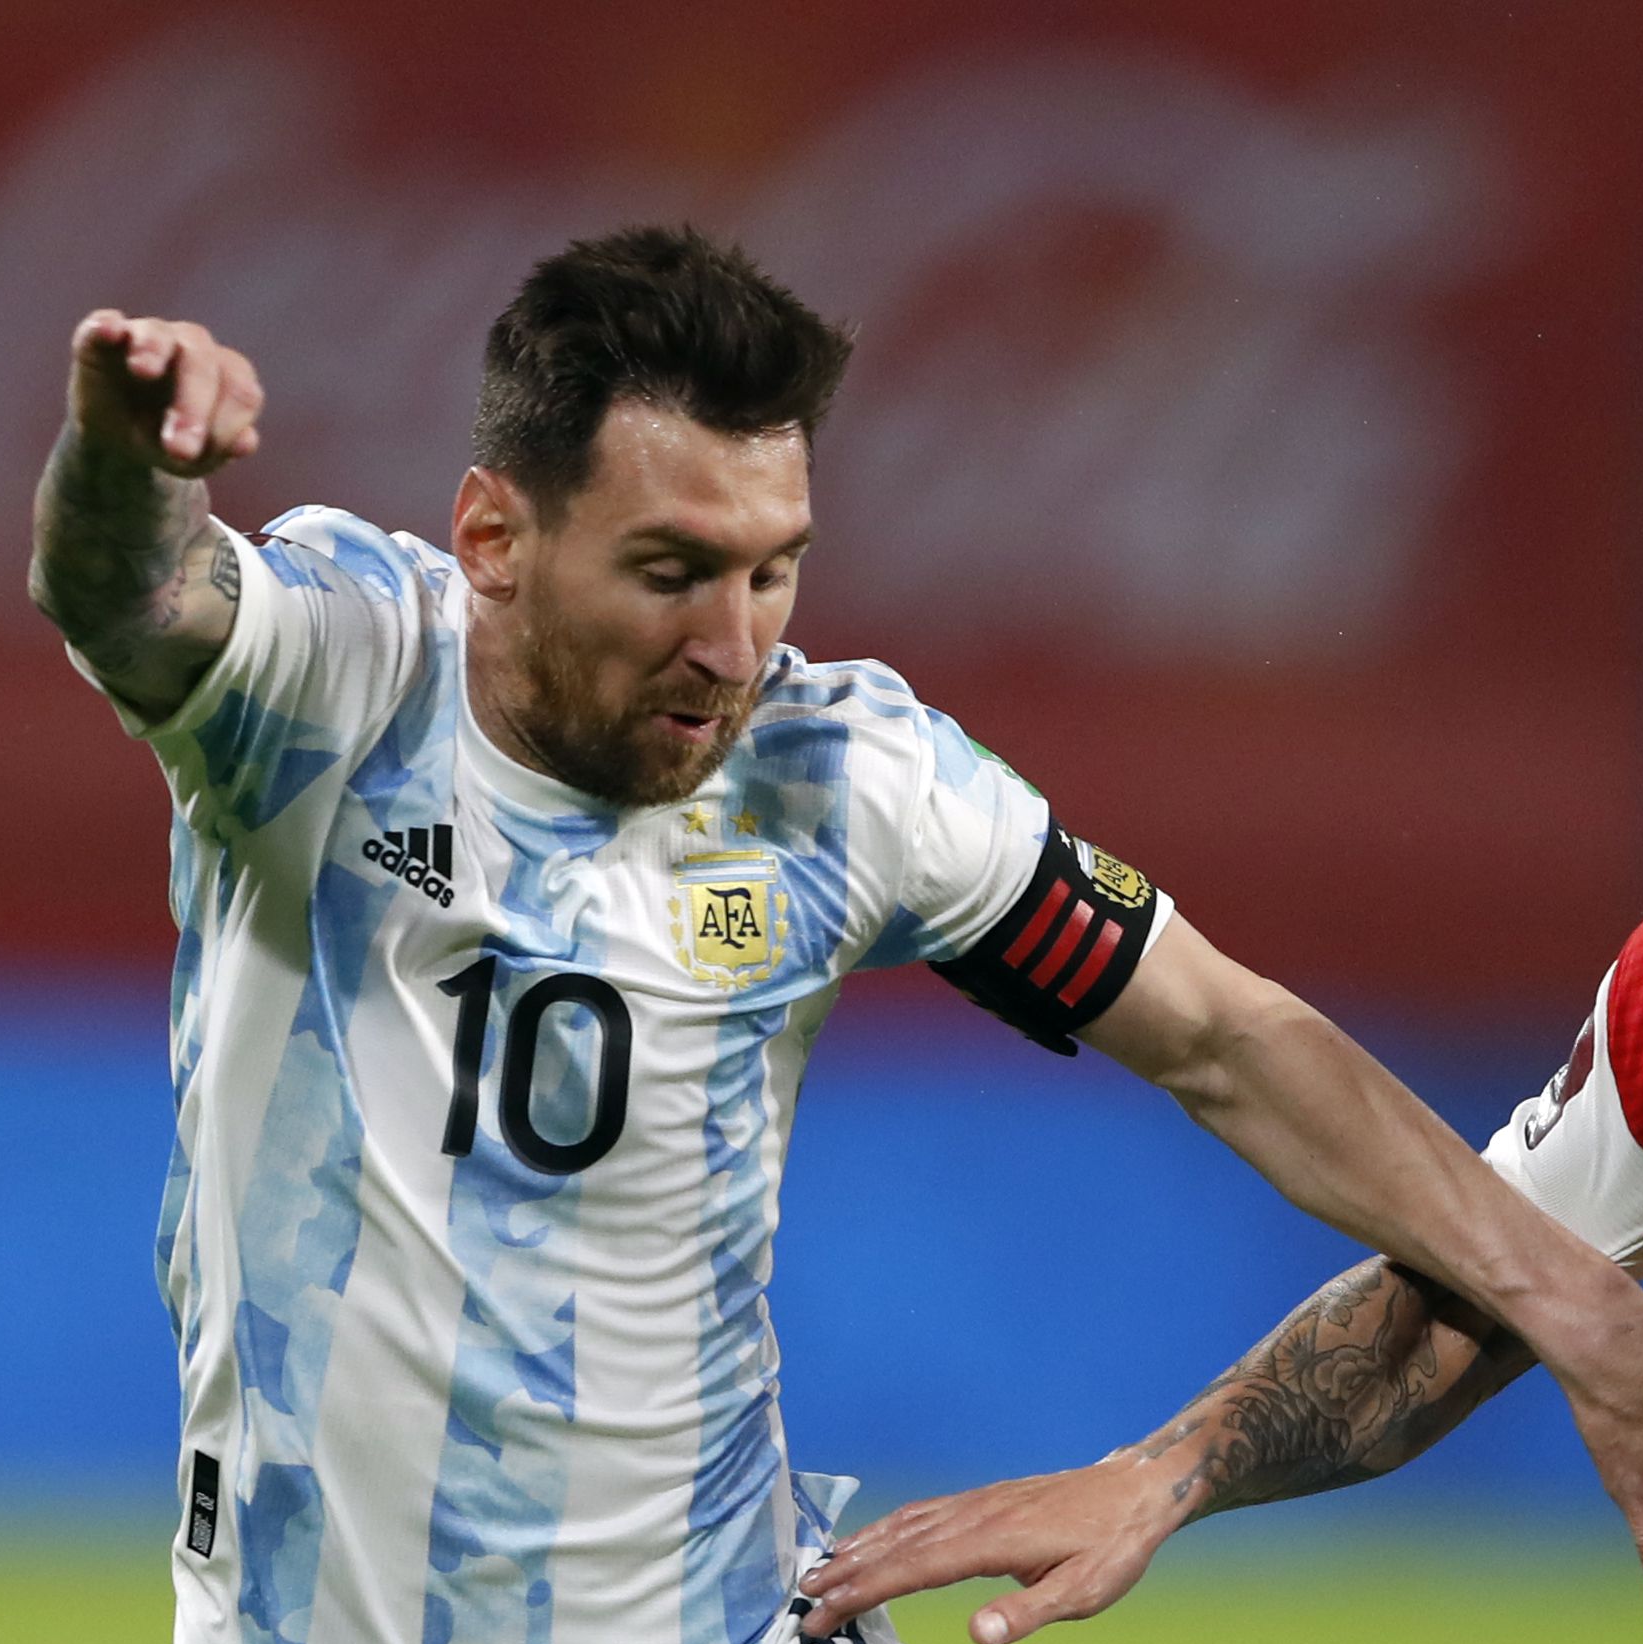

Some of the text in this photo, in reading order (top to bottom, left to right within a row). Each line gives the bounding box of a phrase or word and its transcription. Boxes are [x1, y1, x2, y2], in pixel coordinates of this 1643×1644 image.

[362, 839, 455, 909] adidas
[699, 887, 762, 950] AFA
[437, 955, 632, 1176] 10
